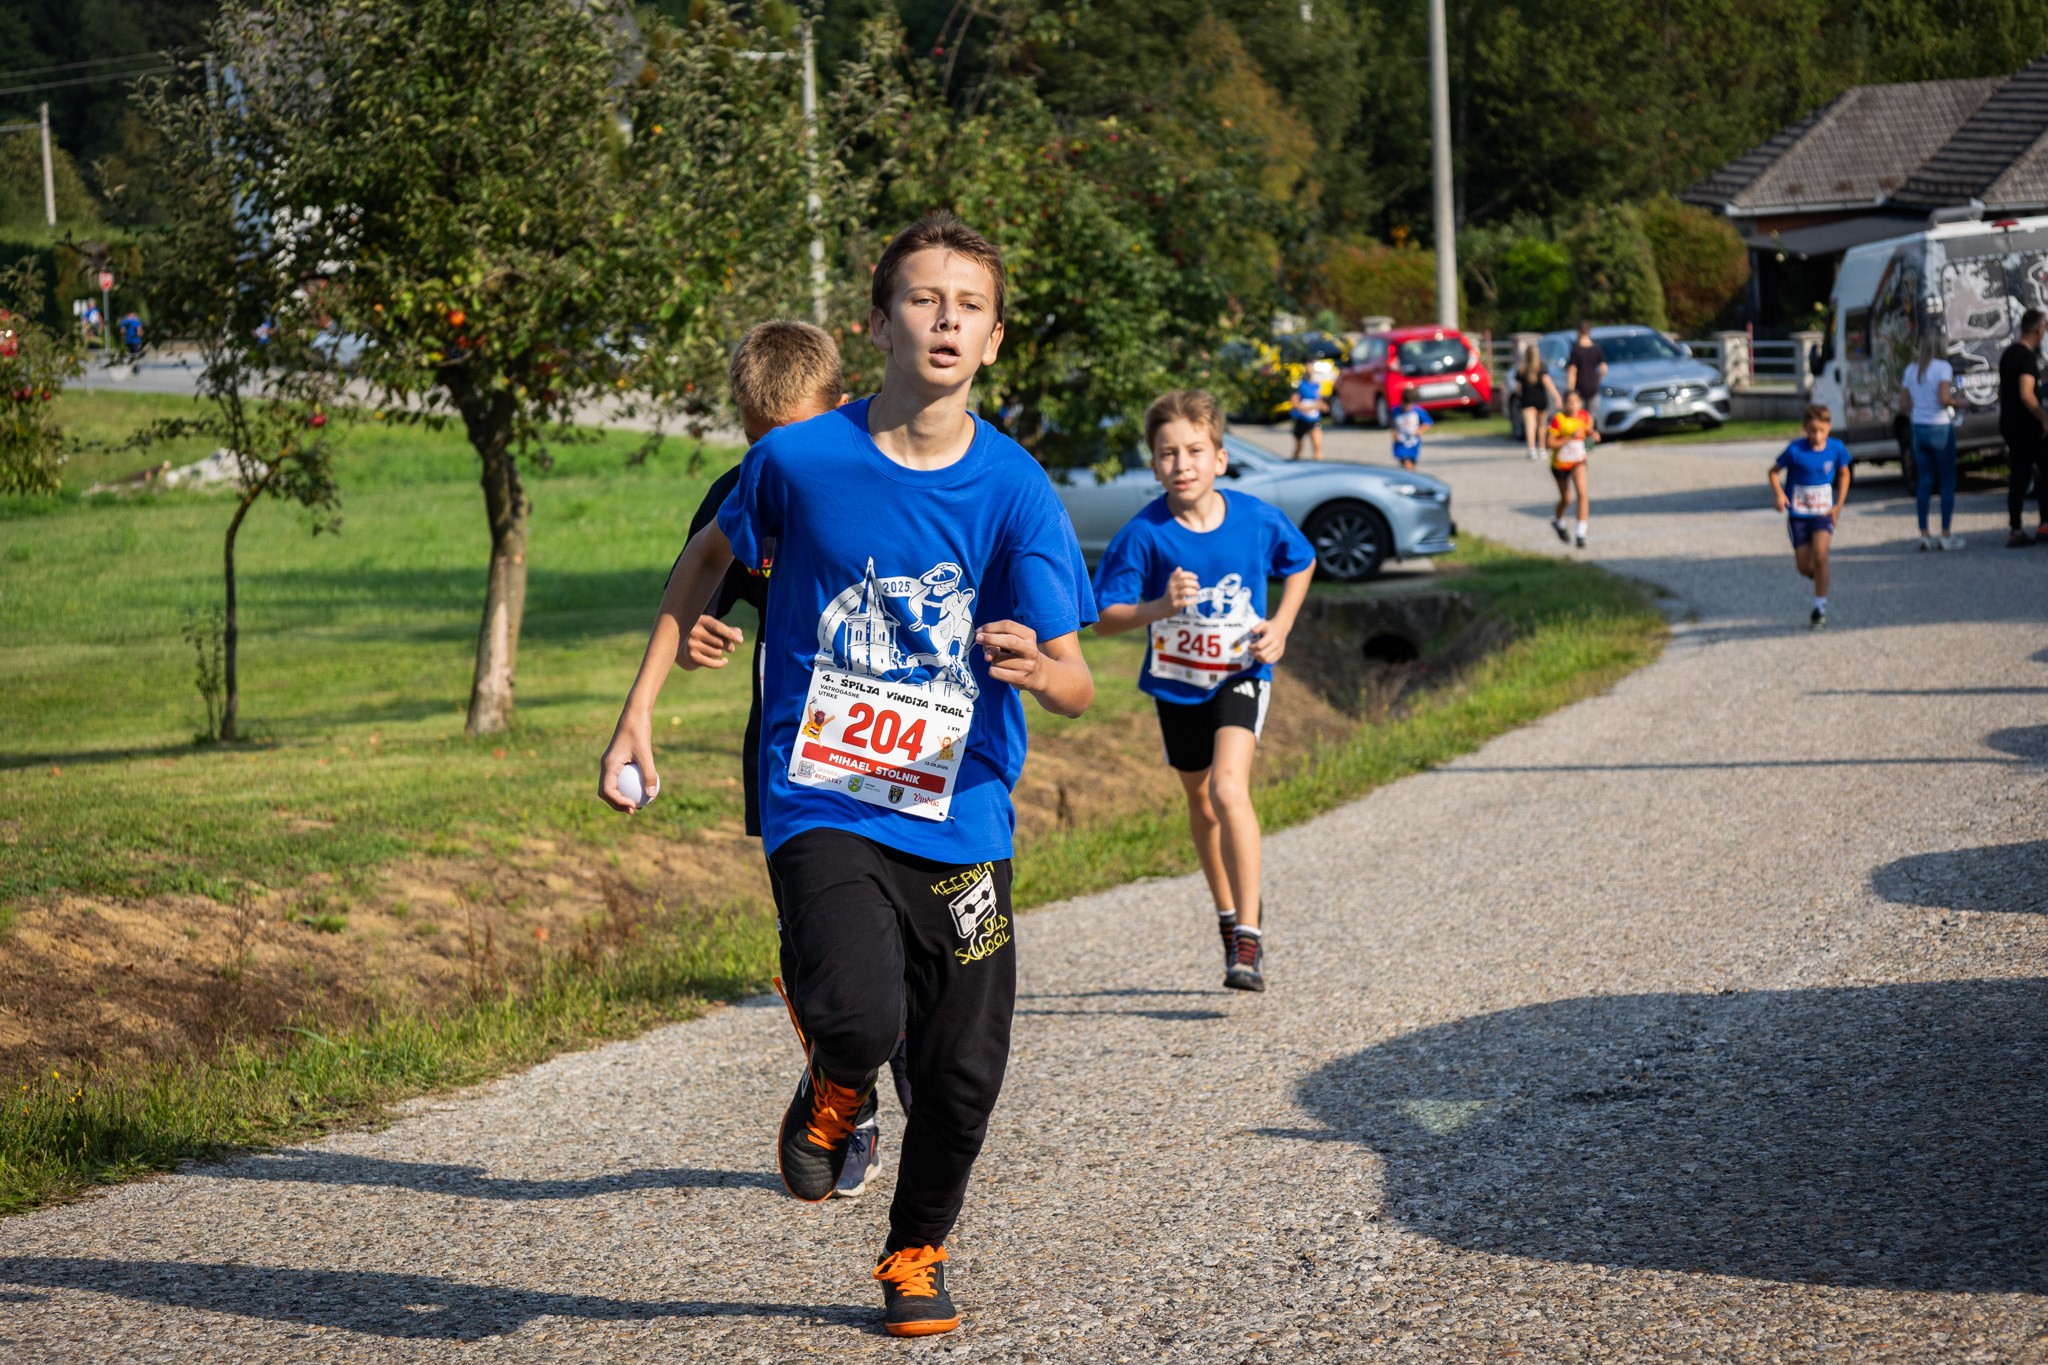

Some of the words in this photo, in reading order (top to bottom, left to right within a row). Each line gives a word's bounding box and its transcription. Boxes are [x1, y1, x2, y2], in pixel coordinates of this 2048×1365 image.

[883, 581, 913, 594] 2025.
[1177, 630, 1222, 658] 245
[818, 690, 838, 700] UTRKE
[820, 683, 860, 699] VATROGASNE
[822, 673, 834, 683] 4.
[886, 691, 929, 709] VINDIJA
[934, 703, 965, 719] TRAIL
[841, 702, 927, 762] 204
[814, 773, 843, 786] REZULTAT
[828, 752, 872, 773] MIHAEL
[875, 765, 921, 785] STOLNIK
